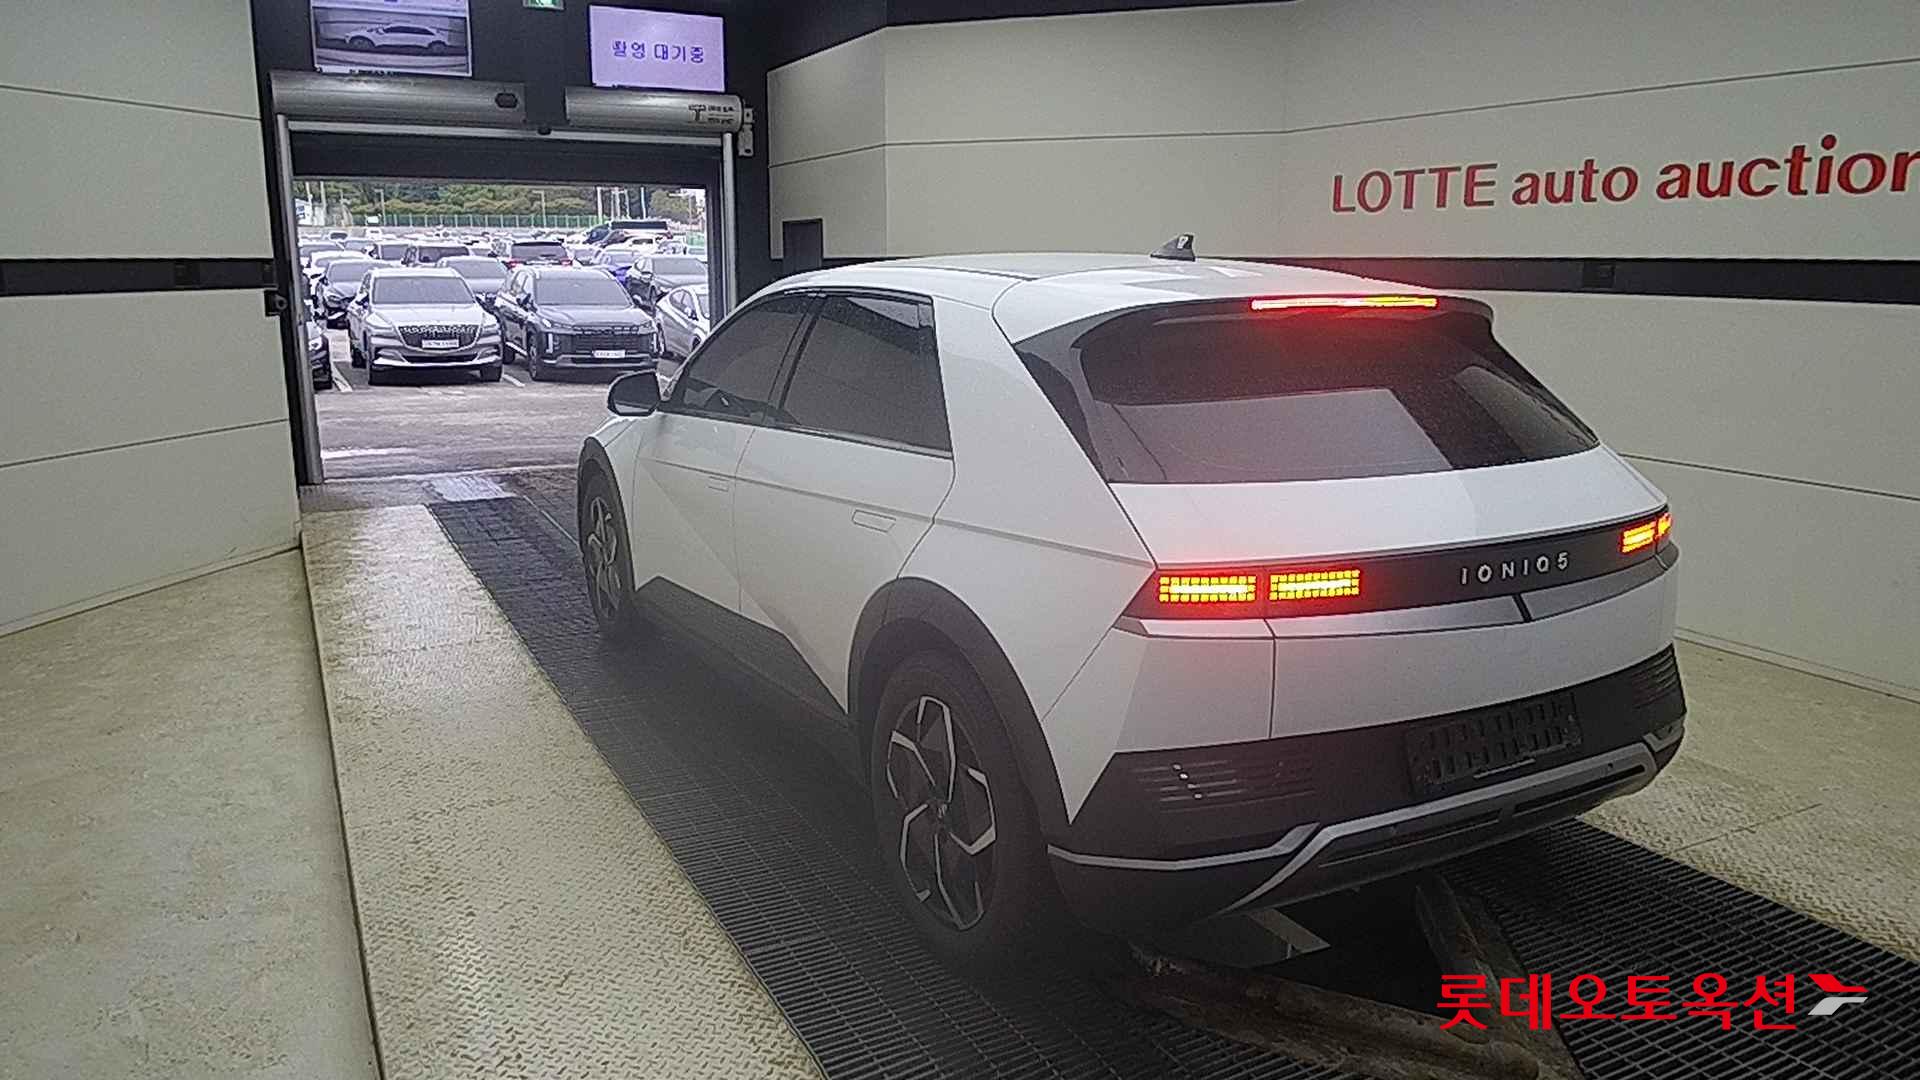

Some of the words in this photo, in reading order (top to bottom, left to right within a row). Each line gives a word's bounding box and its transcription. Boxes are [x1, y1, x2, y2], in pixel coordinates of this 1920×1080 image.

[654, 44, 704, 63] 대기중
[1331, 162, 1499, 213] LOTTE
[1510, 158, 1638, 205] auto
